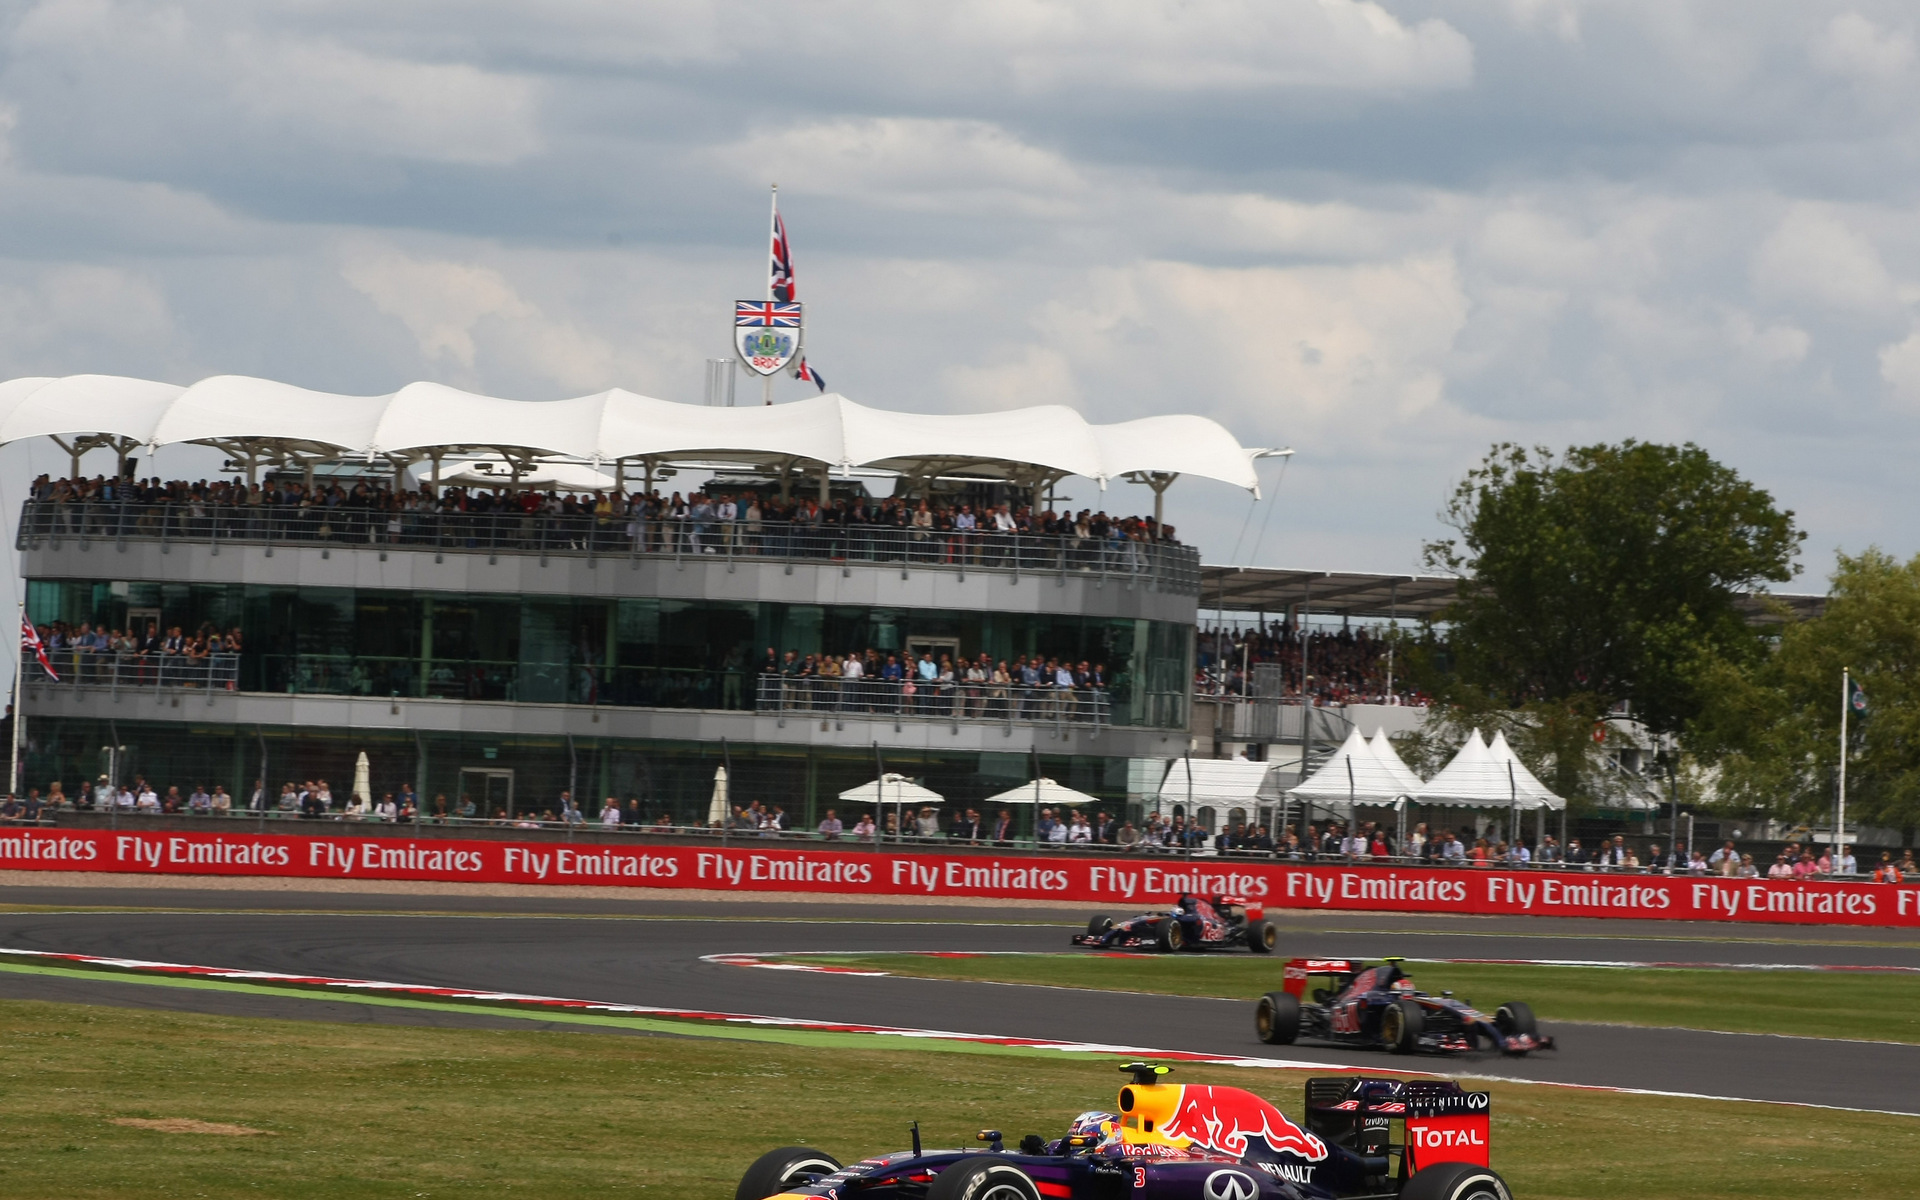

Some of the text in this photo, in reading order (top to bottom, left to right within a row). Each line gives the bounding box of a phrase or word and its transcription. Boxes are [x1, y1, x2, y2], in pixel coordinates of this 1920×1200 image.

[753, 357, 780, 369] BRDC
[117, 837, 288, 867] Fly Emirates
[310, 842, 482, 872] Fly Emirates
[505, 848, 678, 878] Fly Emirates
[698, 854, 871, 884] Fly Emirates
[893, 861, 1067, 891] Fly Emirates
[1091, 867, 1268, 897] Fly Emirates
[1287, 873, 1466, 903] Fly Emirates
[1488, 878, 1670, 908] Fly Emirates
[1692, 884, 1876, 915] Fly Emirates
[1409, 1096, 1464, 1107] INFINITI
[1121, 1143, 1155, 1156] Red
[1133, 1167, 1145, 1188] 3
[1258, 1162, 1316, 1184] RENAULT
